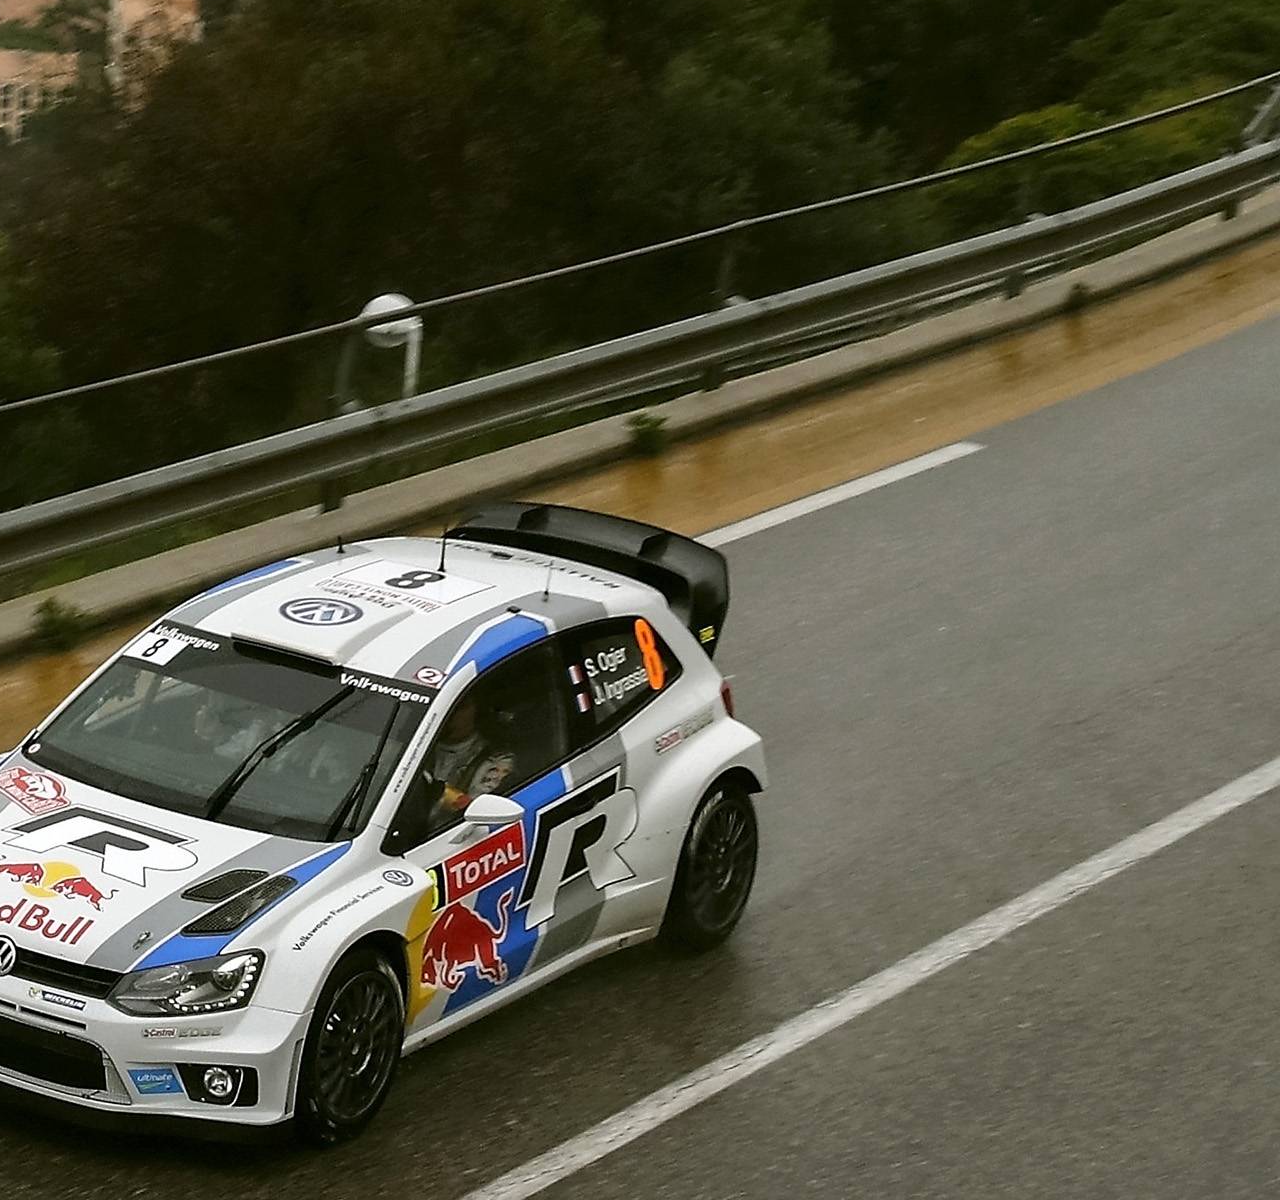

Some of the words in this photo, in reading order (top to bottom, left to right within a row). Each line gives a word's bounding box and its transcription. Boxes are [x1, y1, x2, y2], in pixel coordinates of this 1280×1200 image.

[384, 570, 447, 590] 8
[142, 638, 168, 657] 8
[154, 624, 220, 652] Volkswagen
[584, 657, 600, 677] S.
[597, 647, 627, 673] Ogier
[635, 618, 665, 690] 8
[340, 673, 431, 704] Volkswagen
[423, 669, 437, 680] 2
[449, 841, 521, 889] TOTAL
[292, 914, 333, 952] Volkswagen
[149, 1028, 176, 1037] Castrol
[136, 1072, 174, 1082] ultimate
